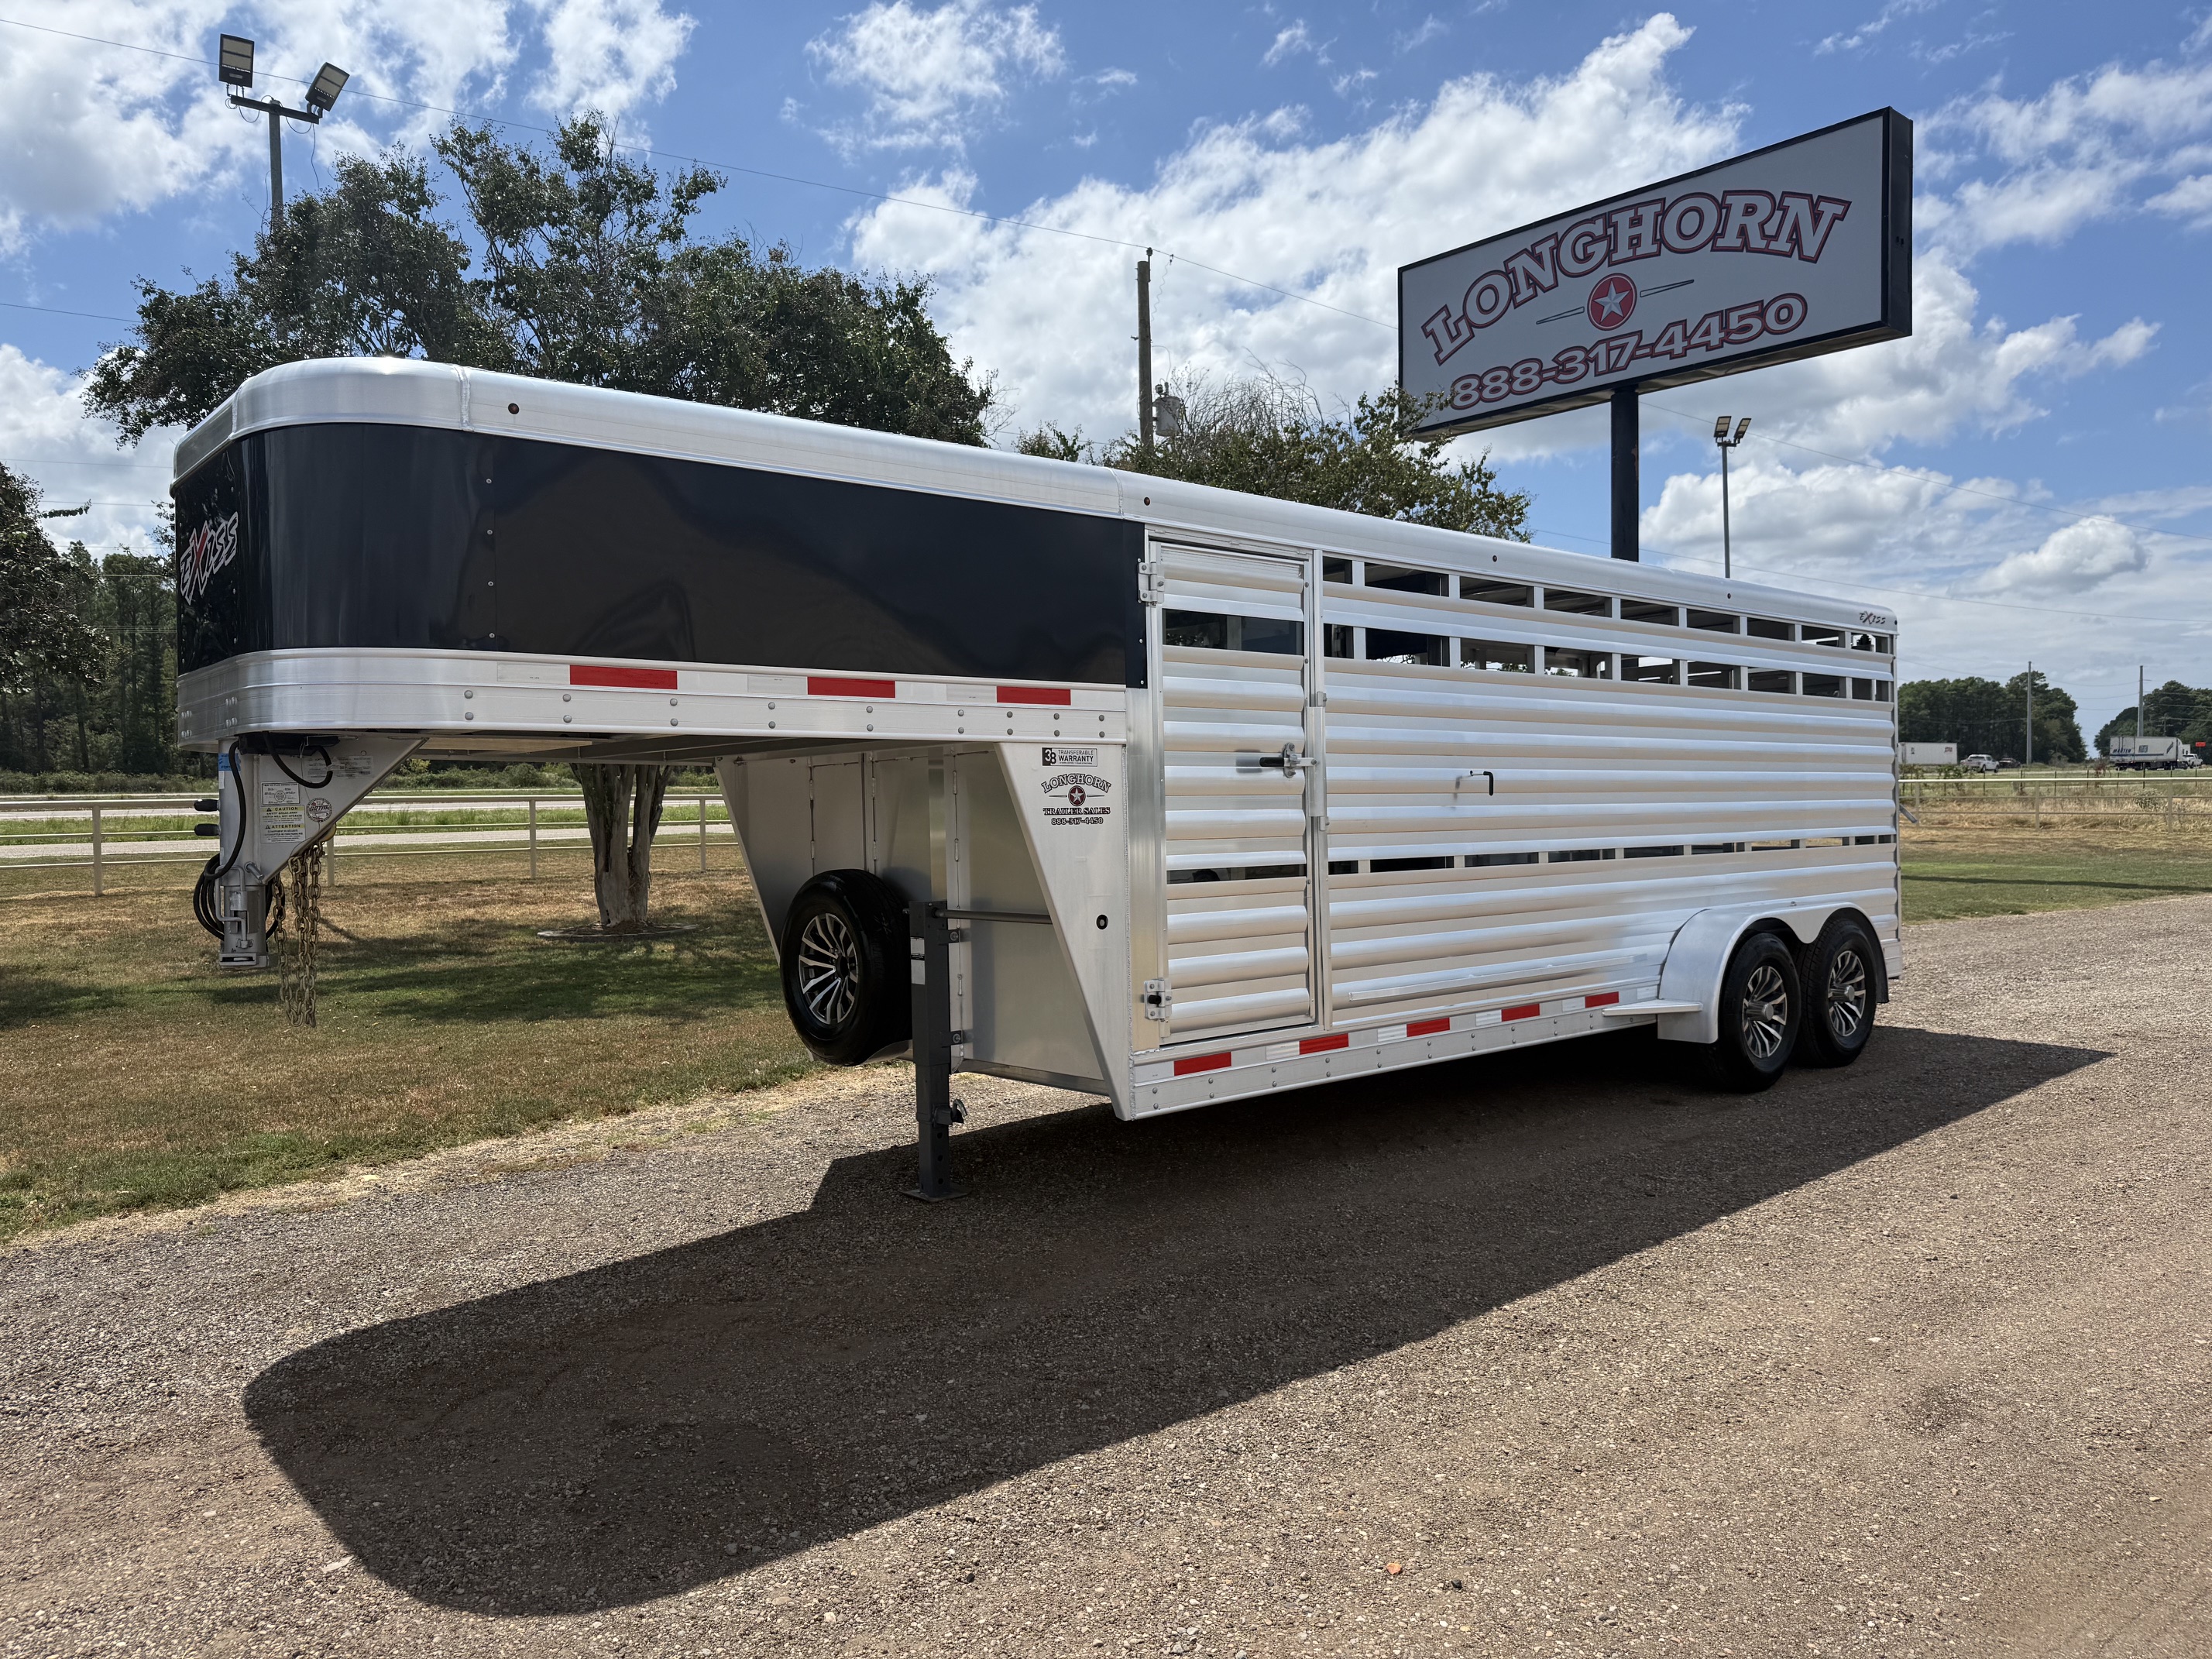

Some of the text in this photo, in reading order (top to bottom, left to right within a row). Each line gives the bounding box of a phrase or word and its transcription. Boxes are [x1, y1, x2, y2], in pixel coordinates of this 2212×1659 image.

[1421, 190, 1852, 366] LONGHORN
[1450, 292, 1808, 410] 888-317-4450
[180, 511, 239, 606] EXISS
[1041, 773, 1112, 794] LONGHORN
[1042, 807, 1083, 816] TRAILER
